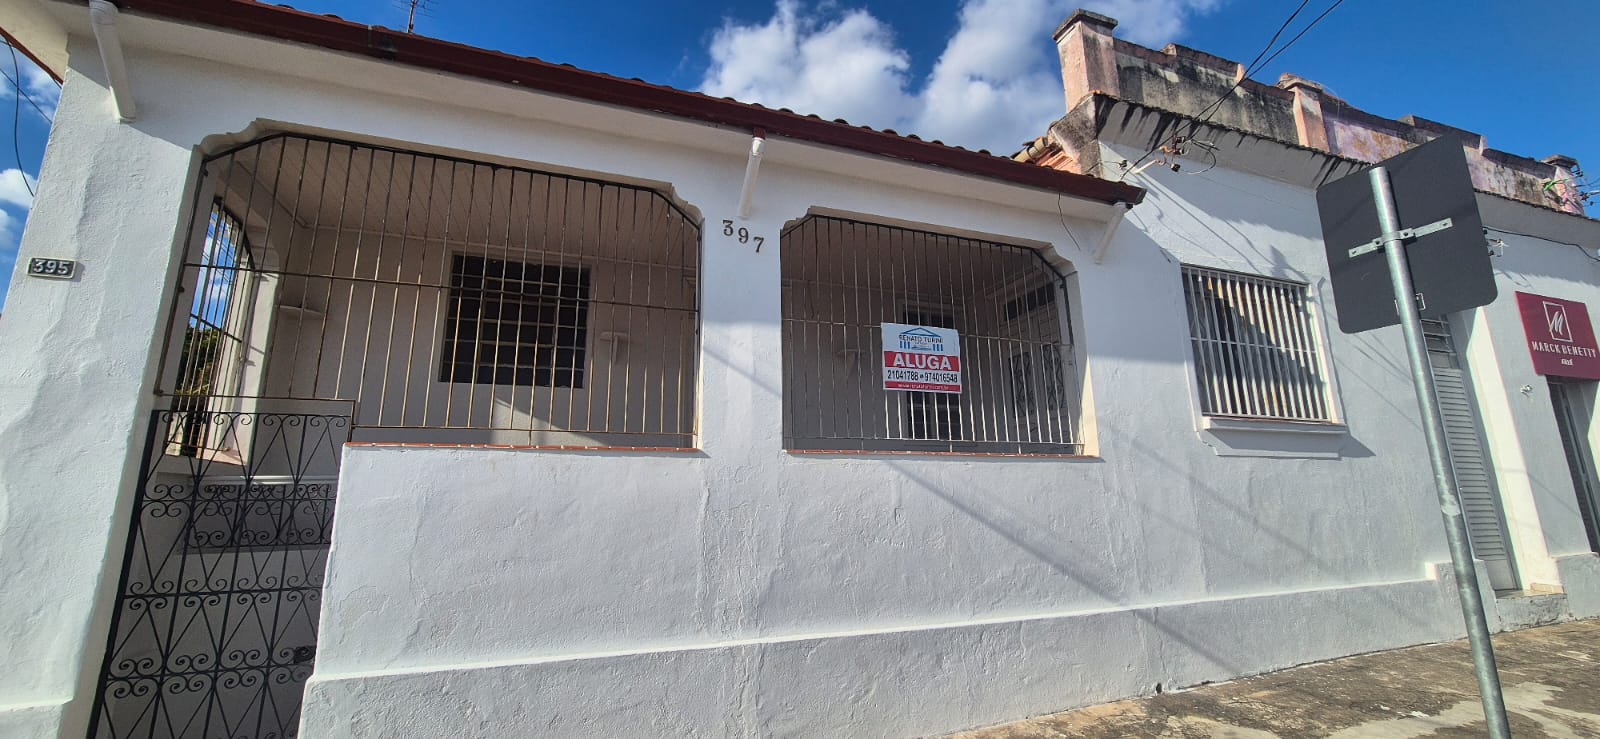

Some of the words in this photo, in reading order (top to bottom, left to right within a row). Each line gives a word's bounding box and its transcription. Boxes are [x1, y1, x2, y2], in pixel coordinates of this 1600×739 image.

[722, 219, 765, 253] 397
[33, 258, 70, 275] 395
[1531, 341, 1561, 353] MARCK
[1561, 345, 1597, 358] BENETTY
[893, 353, 952, 370] ALUGA
[887, 369, 919, 381] 21041788
[925, 372, 958, 383] 974016548
